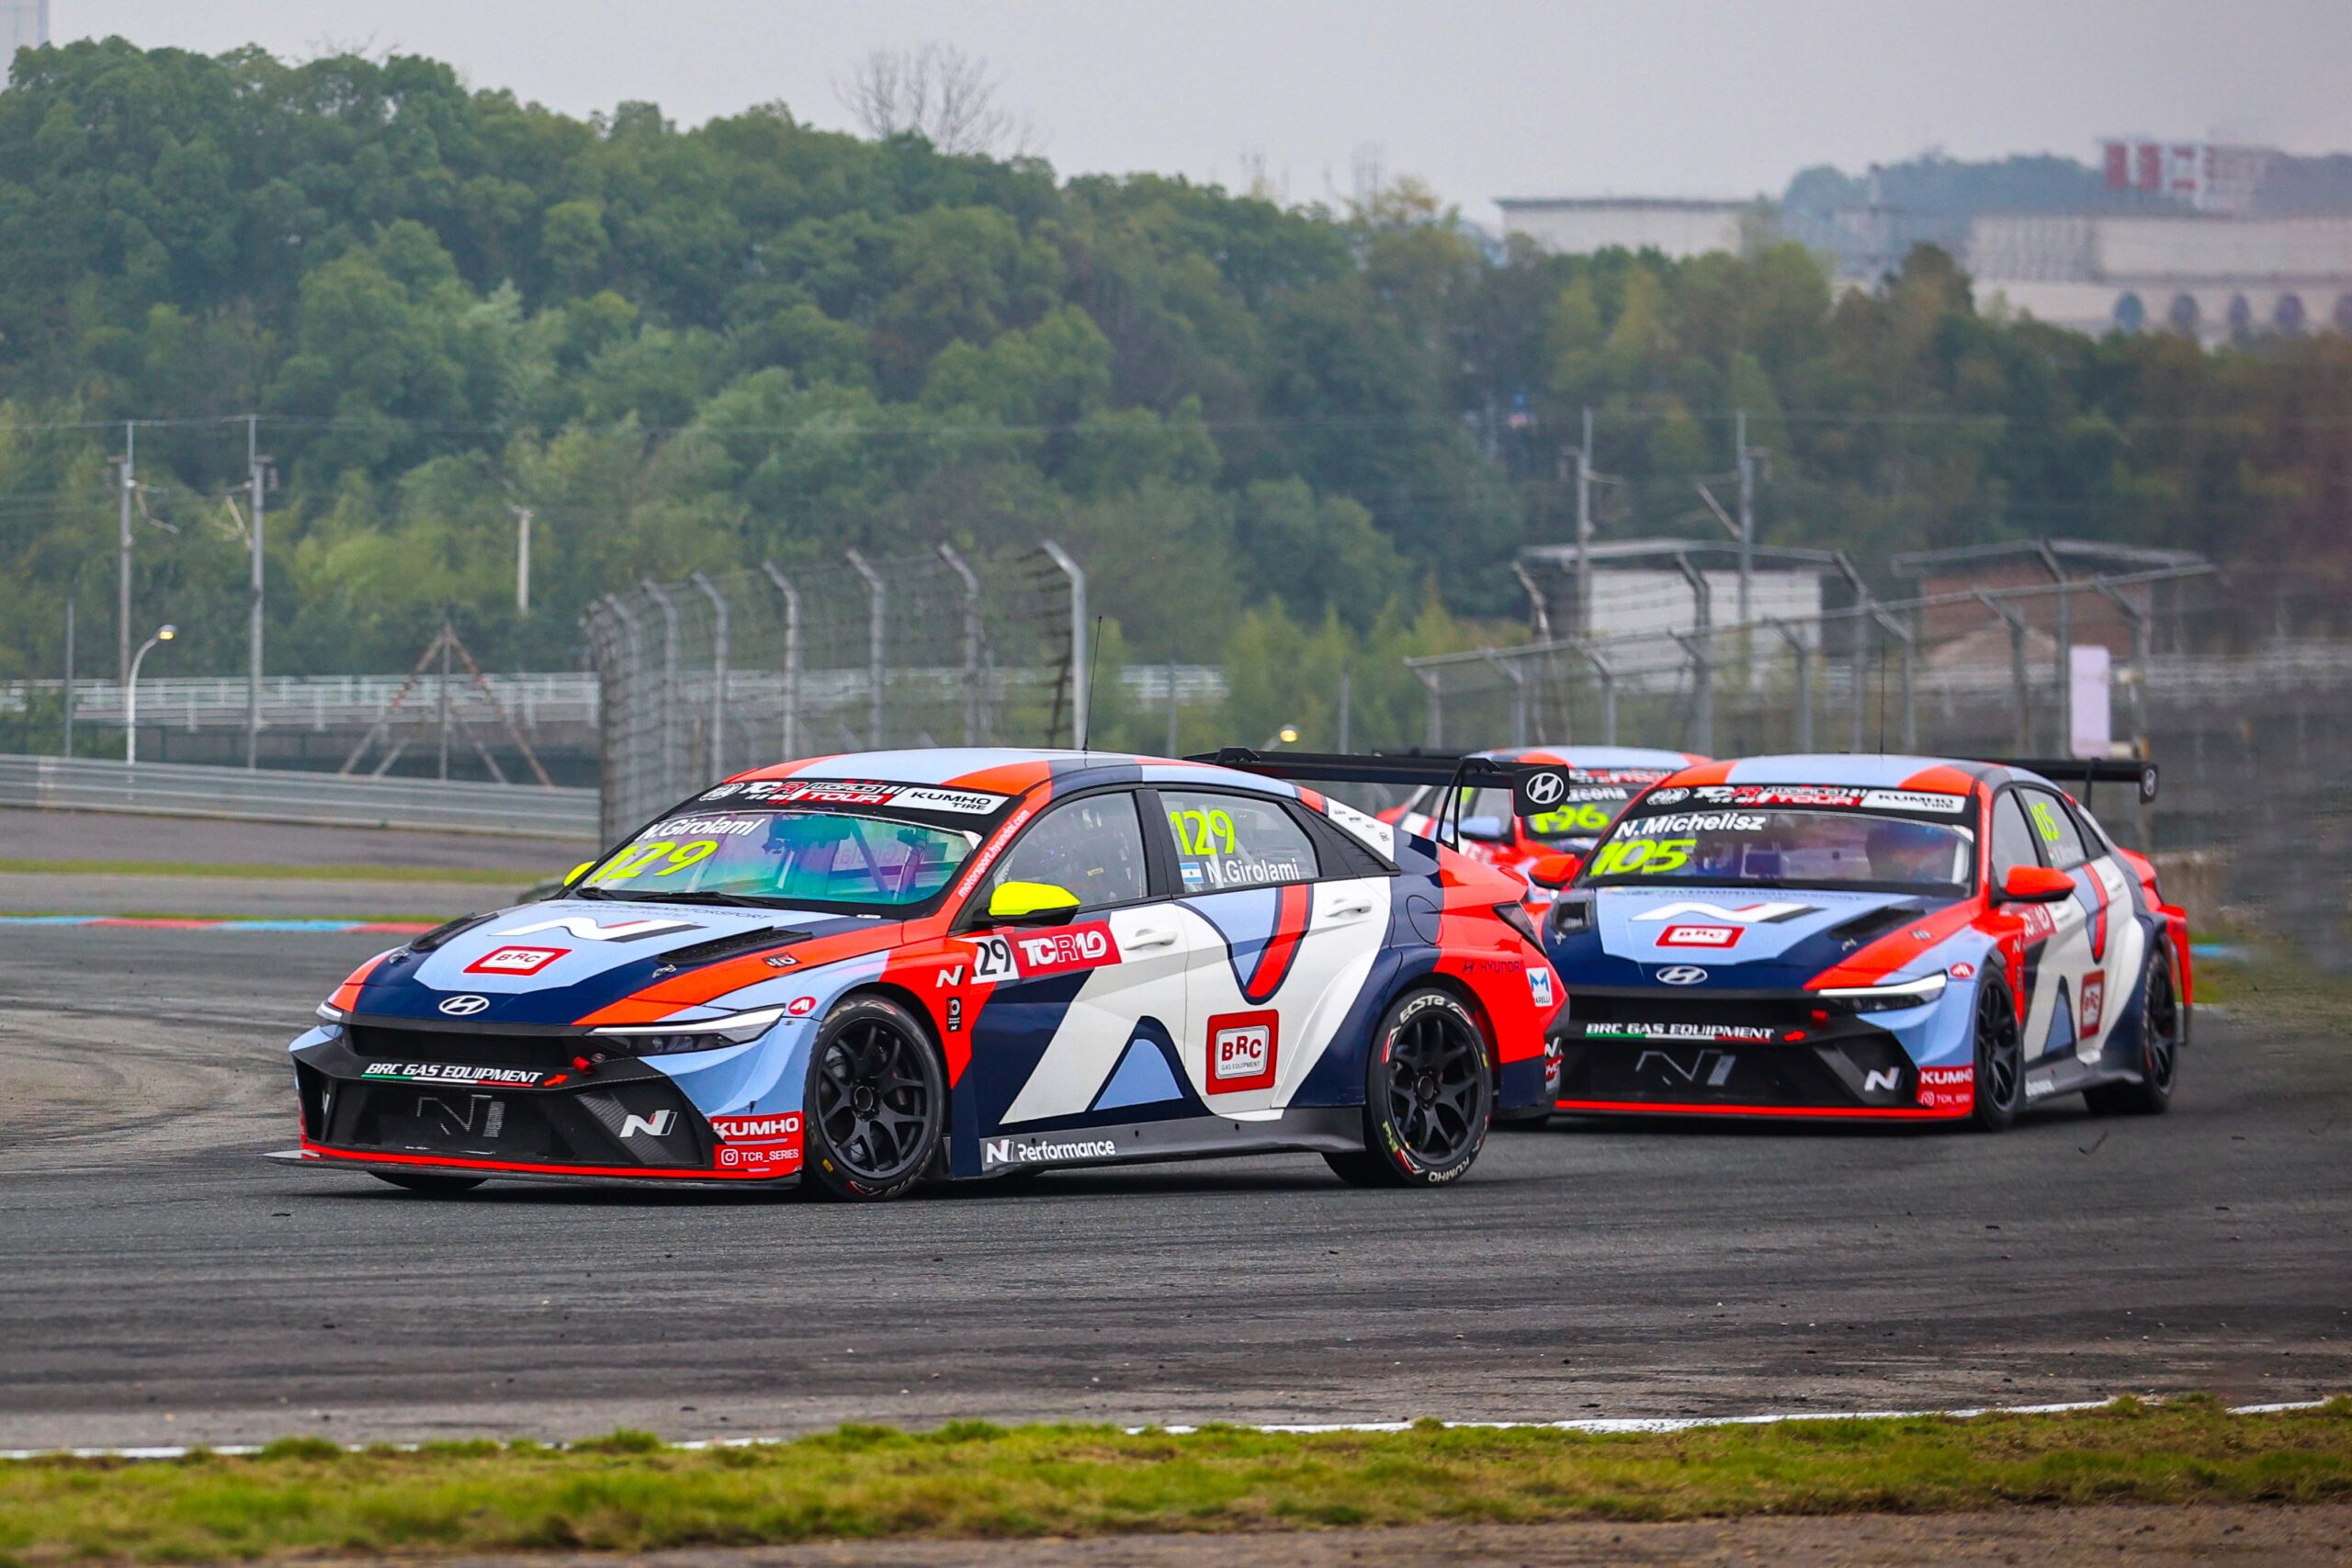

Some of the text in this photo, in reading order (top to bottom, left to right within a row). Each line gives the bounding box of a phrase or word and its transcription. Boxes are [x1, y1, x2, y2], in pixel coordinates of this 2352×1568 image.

[809, 792, 884, 804] TOUR
[910, 791, 991, 806] KUMHO
[952, 802, 986, 811] TIRE
[636, 817, 765, 841] N.Girolami
[1532, 804, 1610, 835] 196
[1614, 814, 1767, 840] N.Michelisz
[1170, 808, 1235, 856] 129
[589, 840, 718, 884] 129
[957, 809, 1030, 898] motorsport.hyundai.com
[1589, 839, 1697, 877] 105
[1204, 858, 1301, 884] N.Girolami
[495, 952, 541, 964] BRC
[972, 939, 1012, 977] 29
[1586, 1022, 1774, 1039] BRC GAS EQUIPMENT
[1221, 1035, 1262, 1062] BRC
[365, 1063, 544, 1083] BRC GAS EQUIPMENT
[1921, 1068, 1973, 1084] KUMHO
[713, 1117, 799, 1137] KUMHO
[741, 1149, 799, 1162] TCR_SERIES
[1017, 1139, 1115, 1162] Performance
